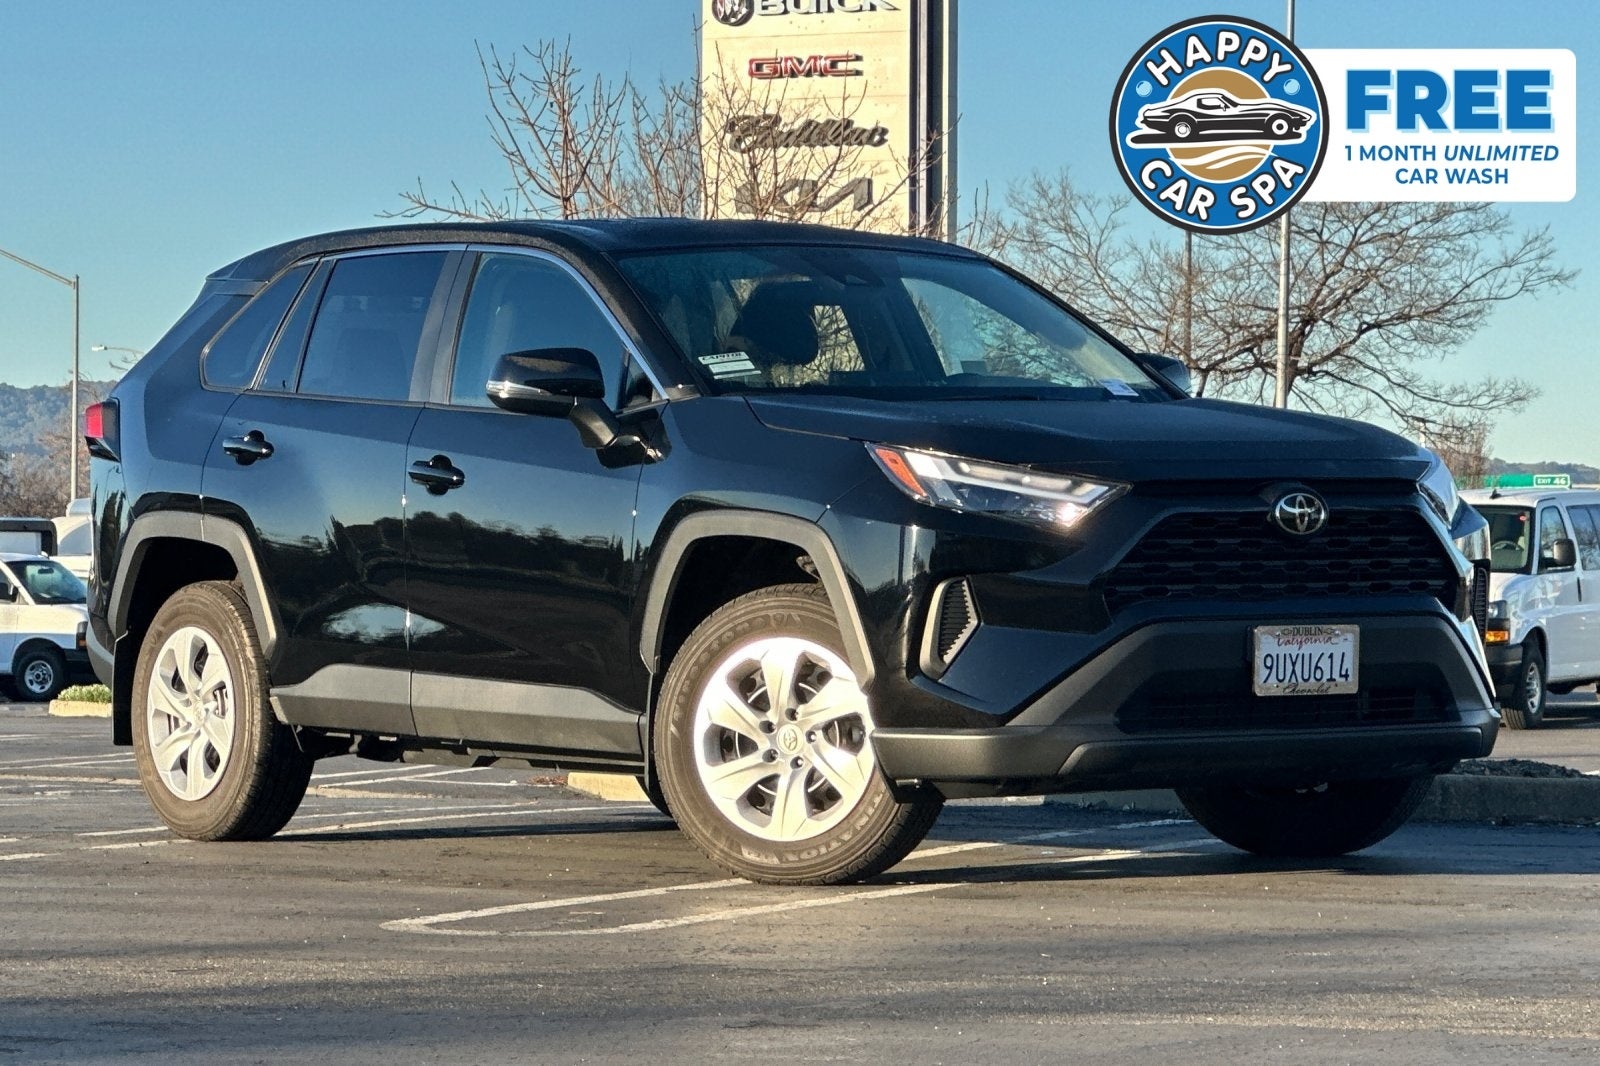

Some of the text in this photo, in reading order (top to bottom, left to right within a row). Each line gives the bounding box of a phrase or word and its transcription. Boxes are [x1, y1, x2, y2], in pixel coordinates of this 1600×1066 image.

[749, 54, 863, 79] GMC
[1553, 477, 1566, 485] 46
[1292, 627, 1324, 636] DUBLIN
[1263, 652, 1350, 683] 9UXU614
